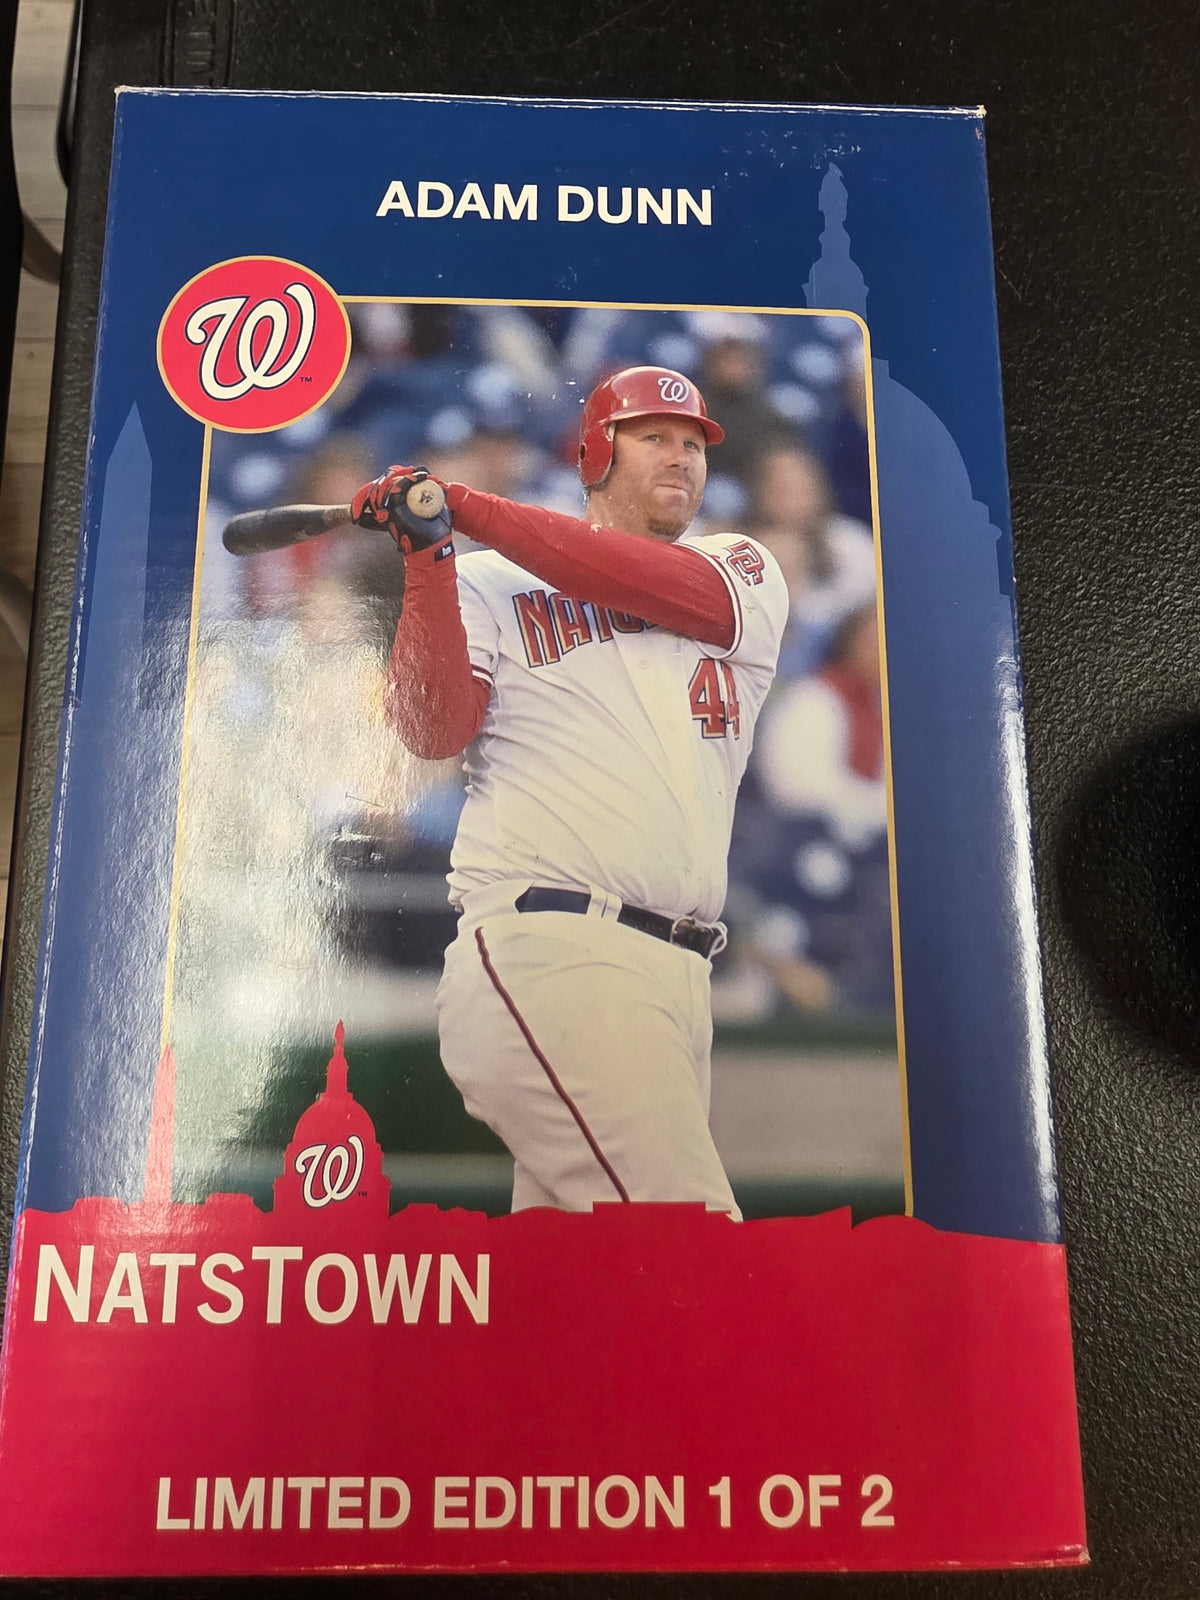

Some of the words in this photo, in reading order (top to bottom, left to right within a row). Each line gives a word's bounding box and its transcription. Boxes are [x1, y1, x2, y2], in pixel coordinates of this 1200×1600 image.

[375, 180, 538, 221] ADAM
[558, 185, 712, 226] DUNN
[185, 282, 317, 401] W
[657, 376, 690, 404] W
[295, 1134, 365, 1209] W
[156, 1476, 411, 1531] LIMITED
[433, 1475, 685, 1530] EDITION
[708, 1475, 731, 1529] 1
[758, 1473, 842, 1529] OF
[860, 1473, 896, 1527] 2
